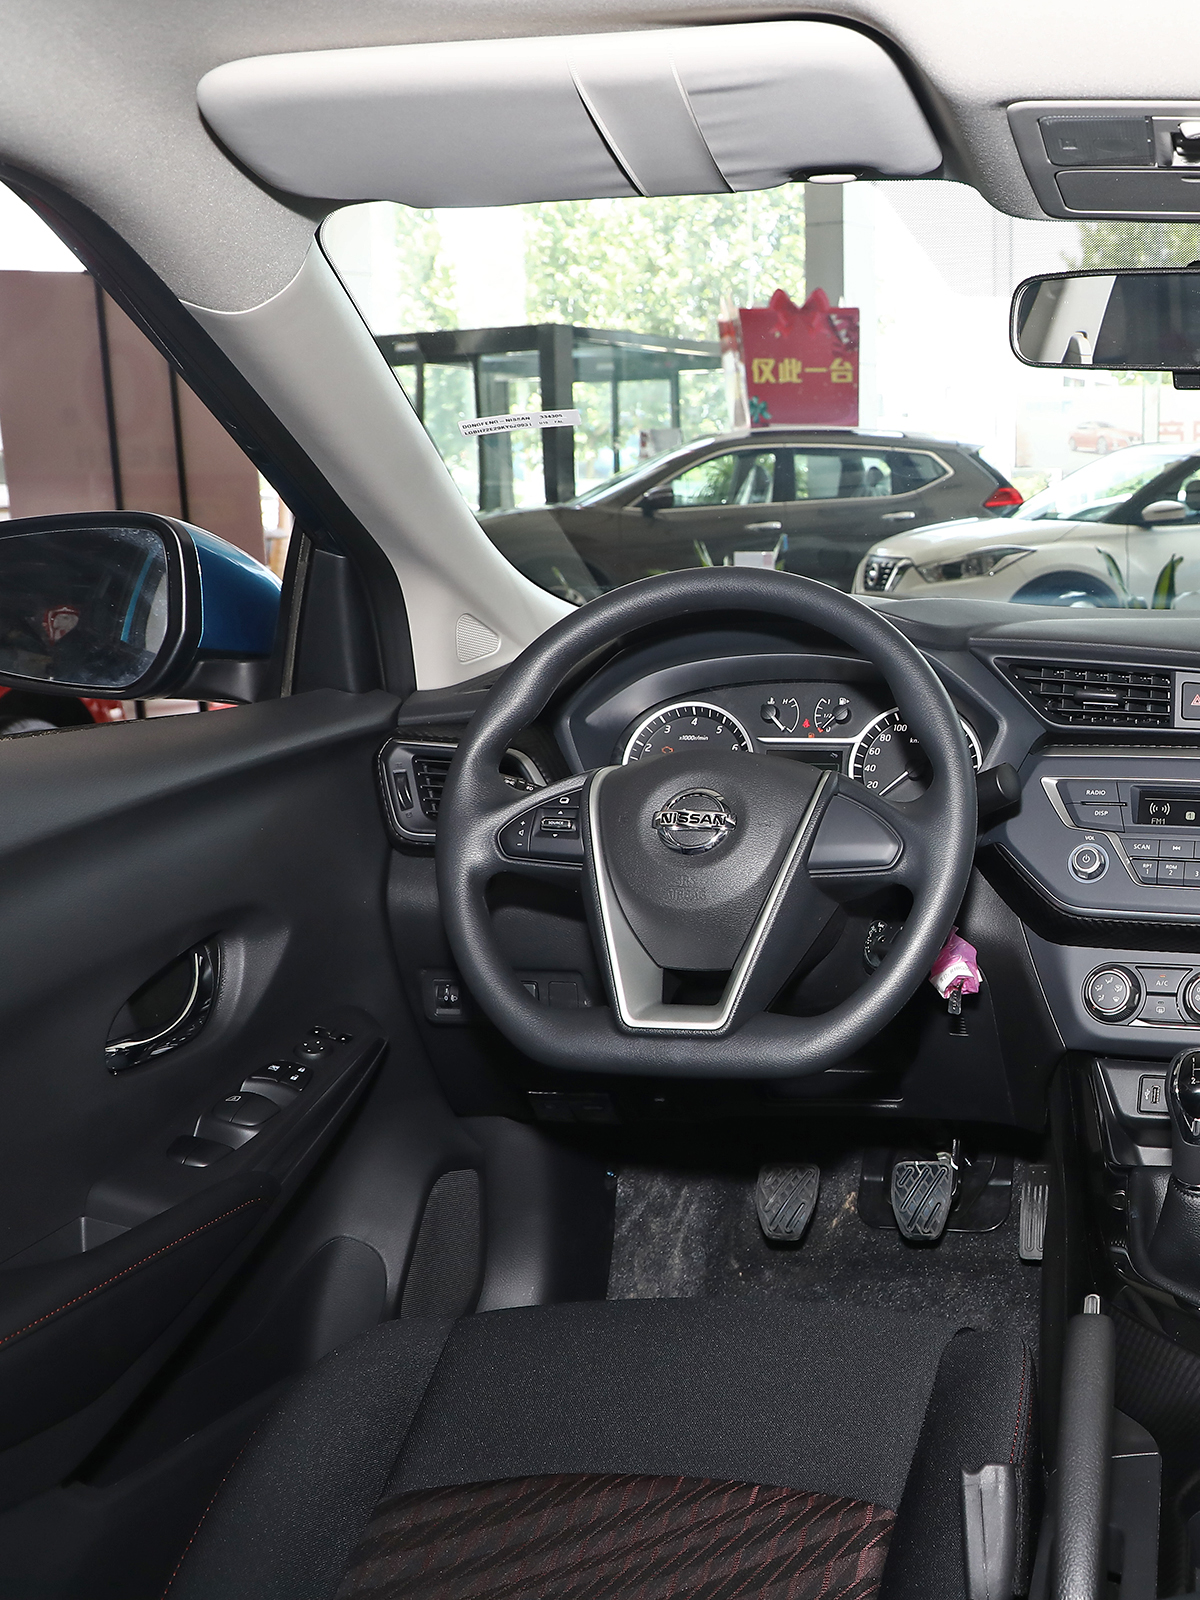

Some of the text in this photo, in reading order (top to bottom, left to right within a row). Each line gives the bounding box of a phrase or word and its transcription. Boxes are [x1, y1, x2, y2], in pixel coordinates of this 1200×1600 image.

[751, 358, 854, 384] 仅此一台
[461, 419, 500, 429] DONGFENG
[691, 717, 699, 726] 4
[664, 724, 672, 734] 3
[715, 725, 723, 734] 5
[893, 724, 908, 732] 100
[880, 734, 892, 742] 80
[644, 743, 653, 752] 2
[731, 743, 739, 751] 6
[868, 747, 881, 756] 60
[864, 764, 877, 772] 40
[866, 780, 879, 789] 20
[660, 811, 727, 826] NISSAN
[1150, 817, 1166, 825] FM1
[1155, 979, 1169, 987] A/C
[1190, 1077, 1196, 1085] 2
